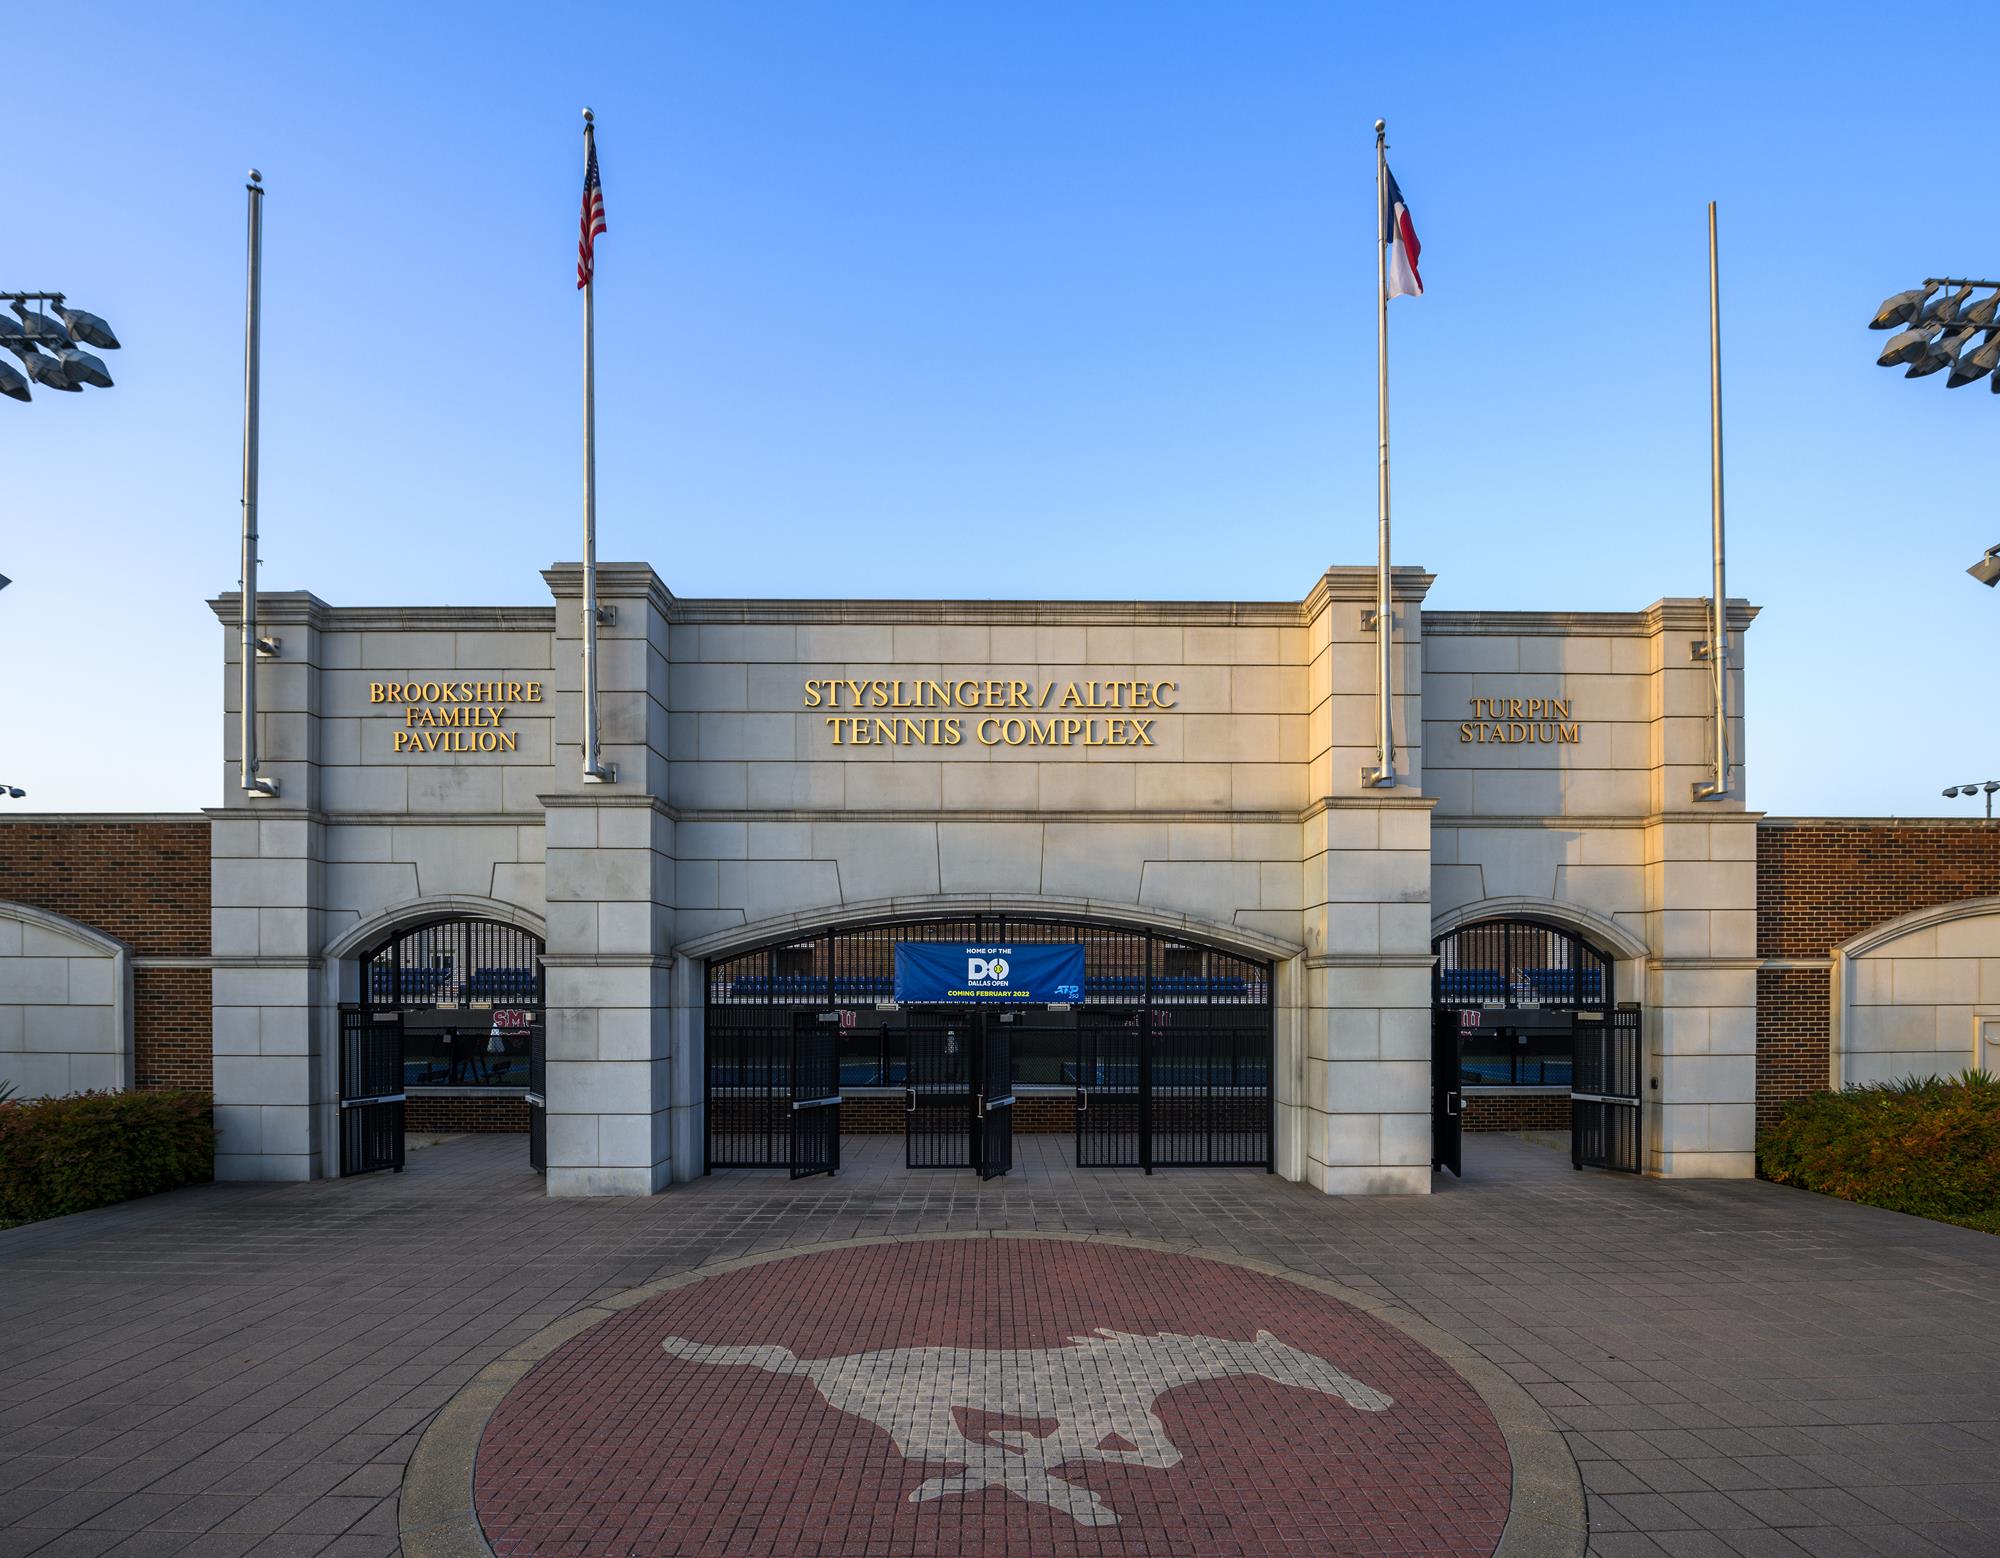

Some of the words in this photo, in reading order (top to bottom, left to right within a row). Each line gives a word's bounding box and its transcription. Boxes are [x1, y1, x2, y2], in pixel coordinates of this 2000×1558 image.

[369, 681, 543, 703] BROOKSHIRE
[405, 706, 505, 728] FAMILY
[1470, 698, 1571, 720] TURPIN
[393, 731, 519, 753] PAVILION
[826, 717, 962, 746] TENNIS
[975, 717, 1155, 746] COMPLEX
[1460, 721, 1581, 744] STADIUM
